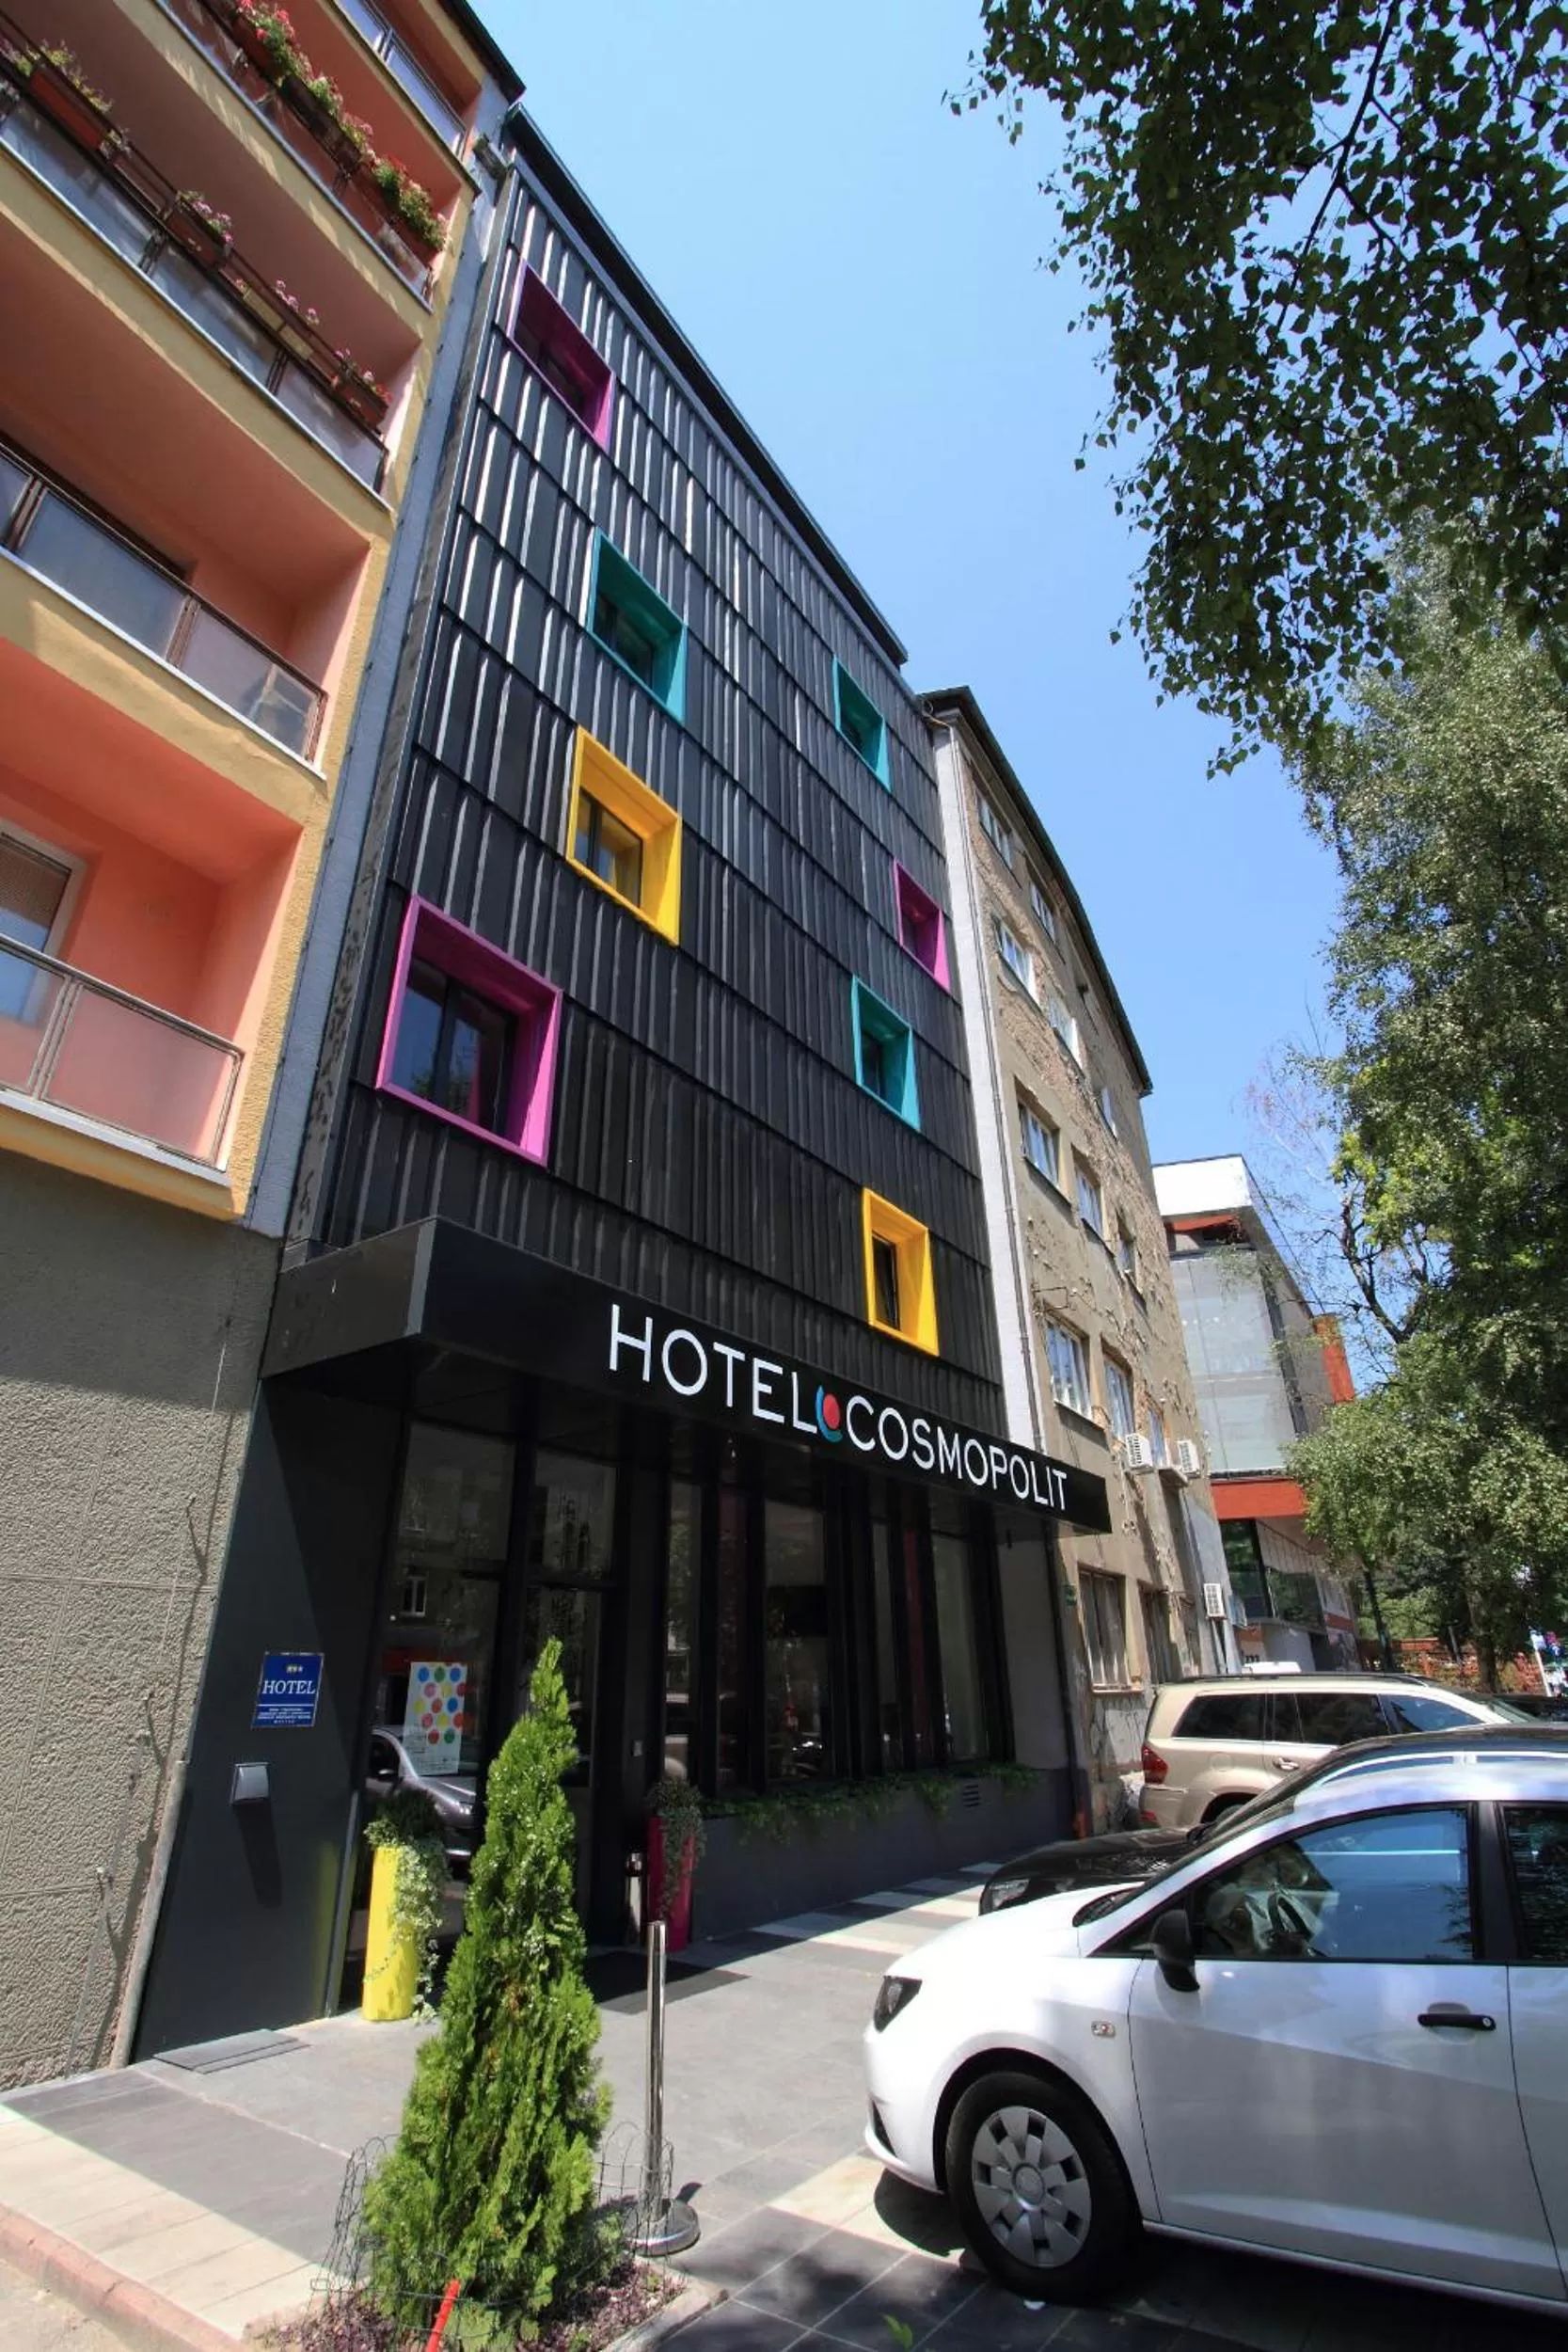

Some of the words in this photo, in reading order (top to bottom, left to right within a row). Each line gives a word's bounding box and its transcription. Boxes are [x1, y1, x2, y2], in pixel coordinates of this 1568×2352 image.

[610, 1304, 817, 1434] HOTEL
[846, 1396, 1068, 1510] COSMOPOLIT
[262, 1679, 316, 1694] HOTEL
